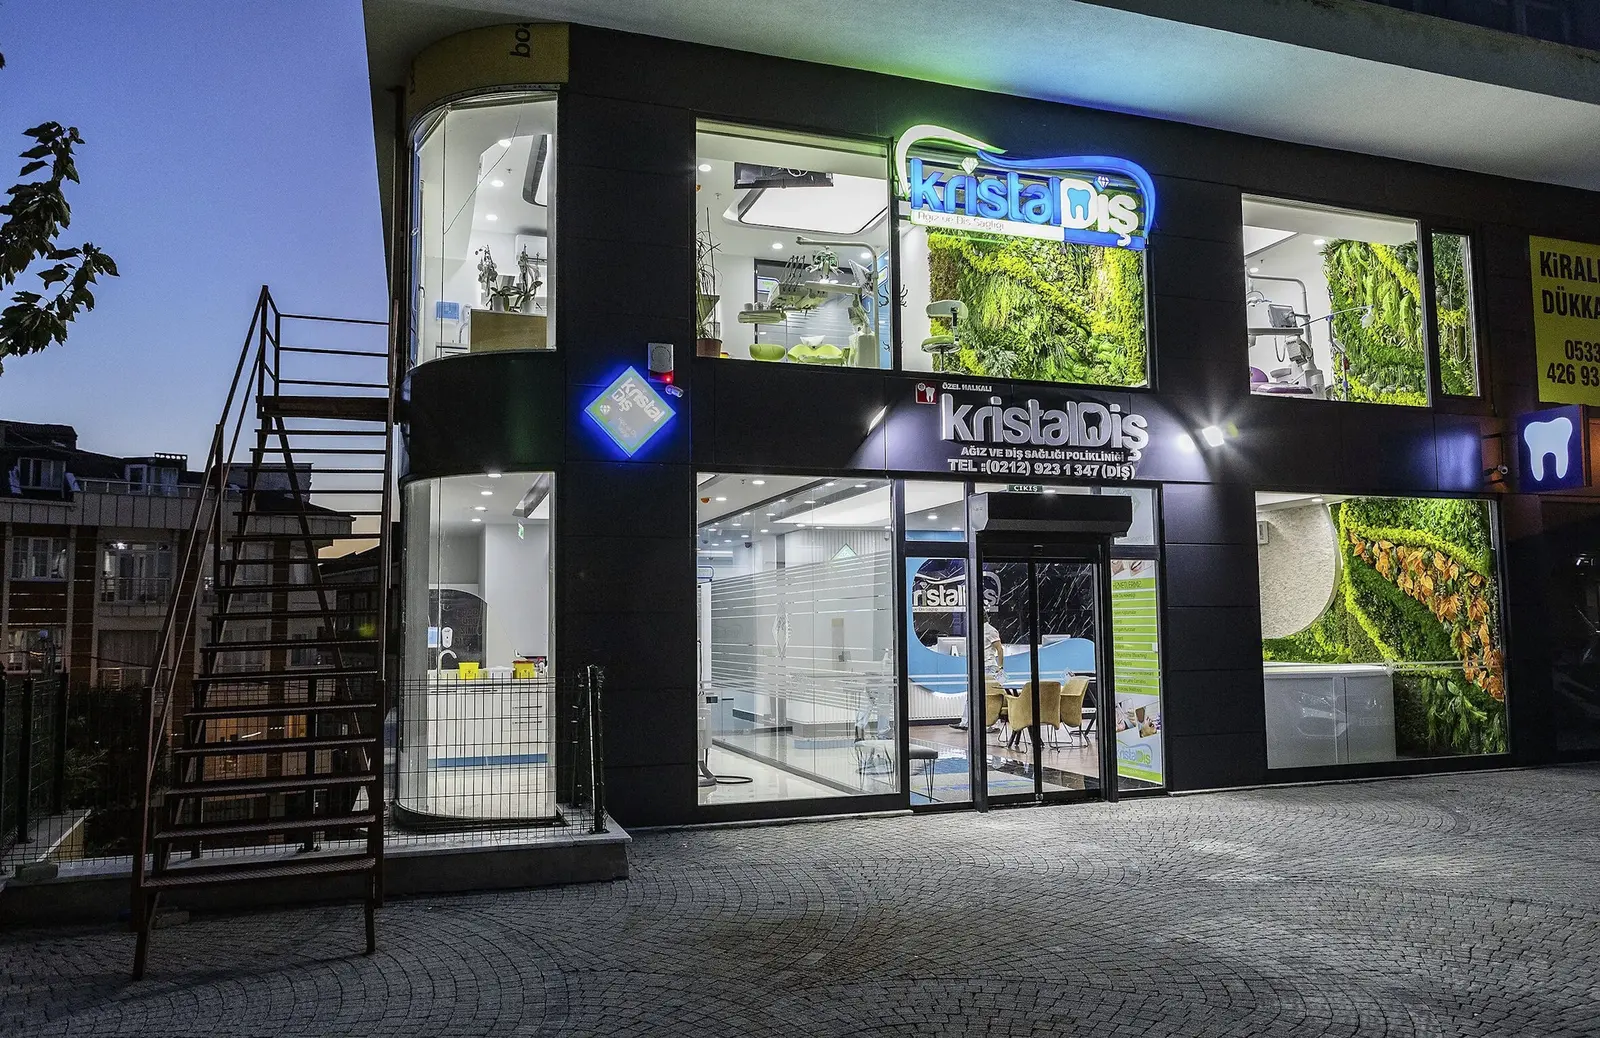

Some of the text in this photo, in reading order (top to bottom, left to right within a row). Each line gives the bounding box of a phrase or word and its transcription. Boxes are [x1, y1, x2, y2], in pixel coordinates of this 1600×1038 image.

[1546, 362, 1576, 384] 426
[961, 383, 993, 393] HALKALI
[961, 445, 1125, 462] AĞIZ VE DİŞ SAĞLIĞI POLİKLİNİĞİ
[948, 458, 978, 472] TEL
[1034, 462, 1061, 476] 923
[1074, 464, 1100, 477] 347
[1101, 465, 1136, 480] (DİŞ)
[1013, 485, 1038, 493] ÇIKIŞ
